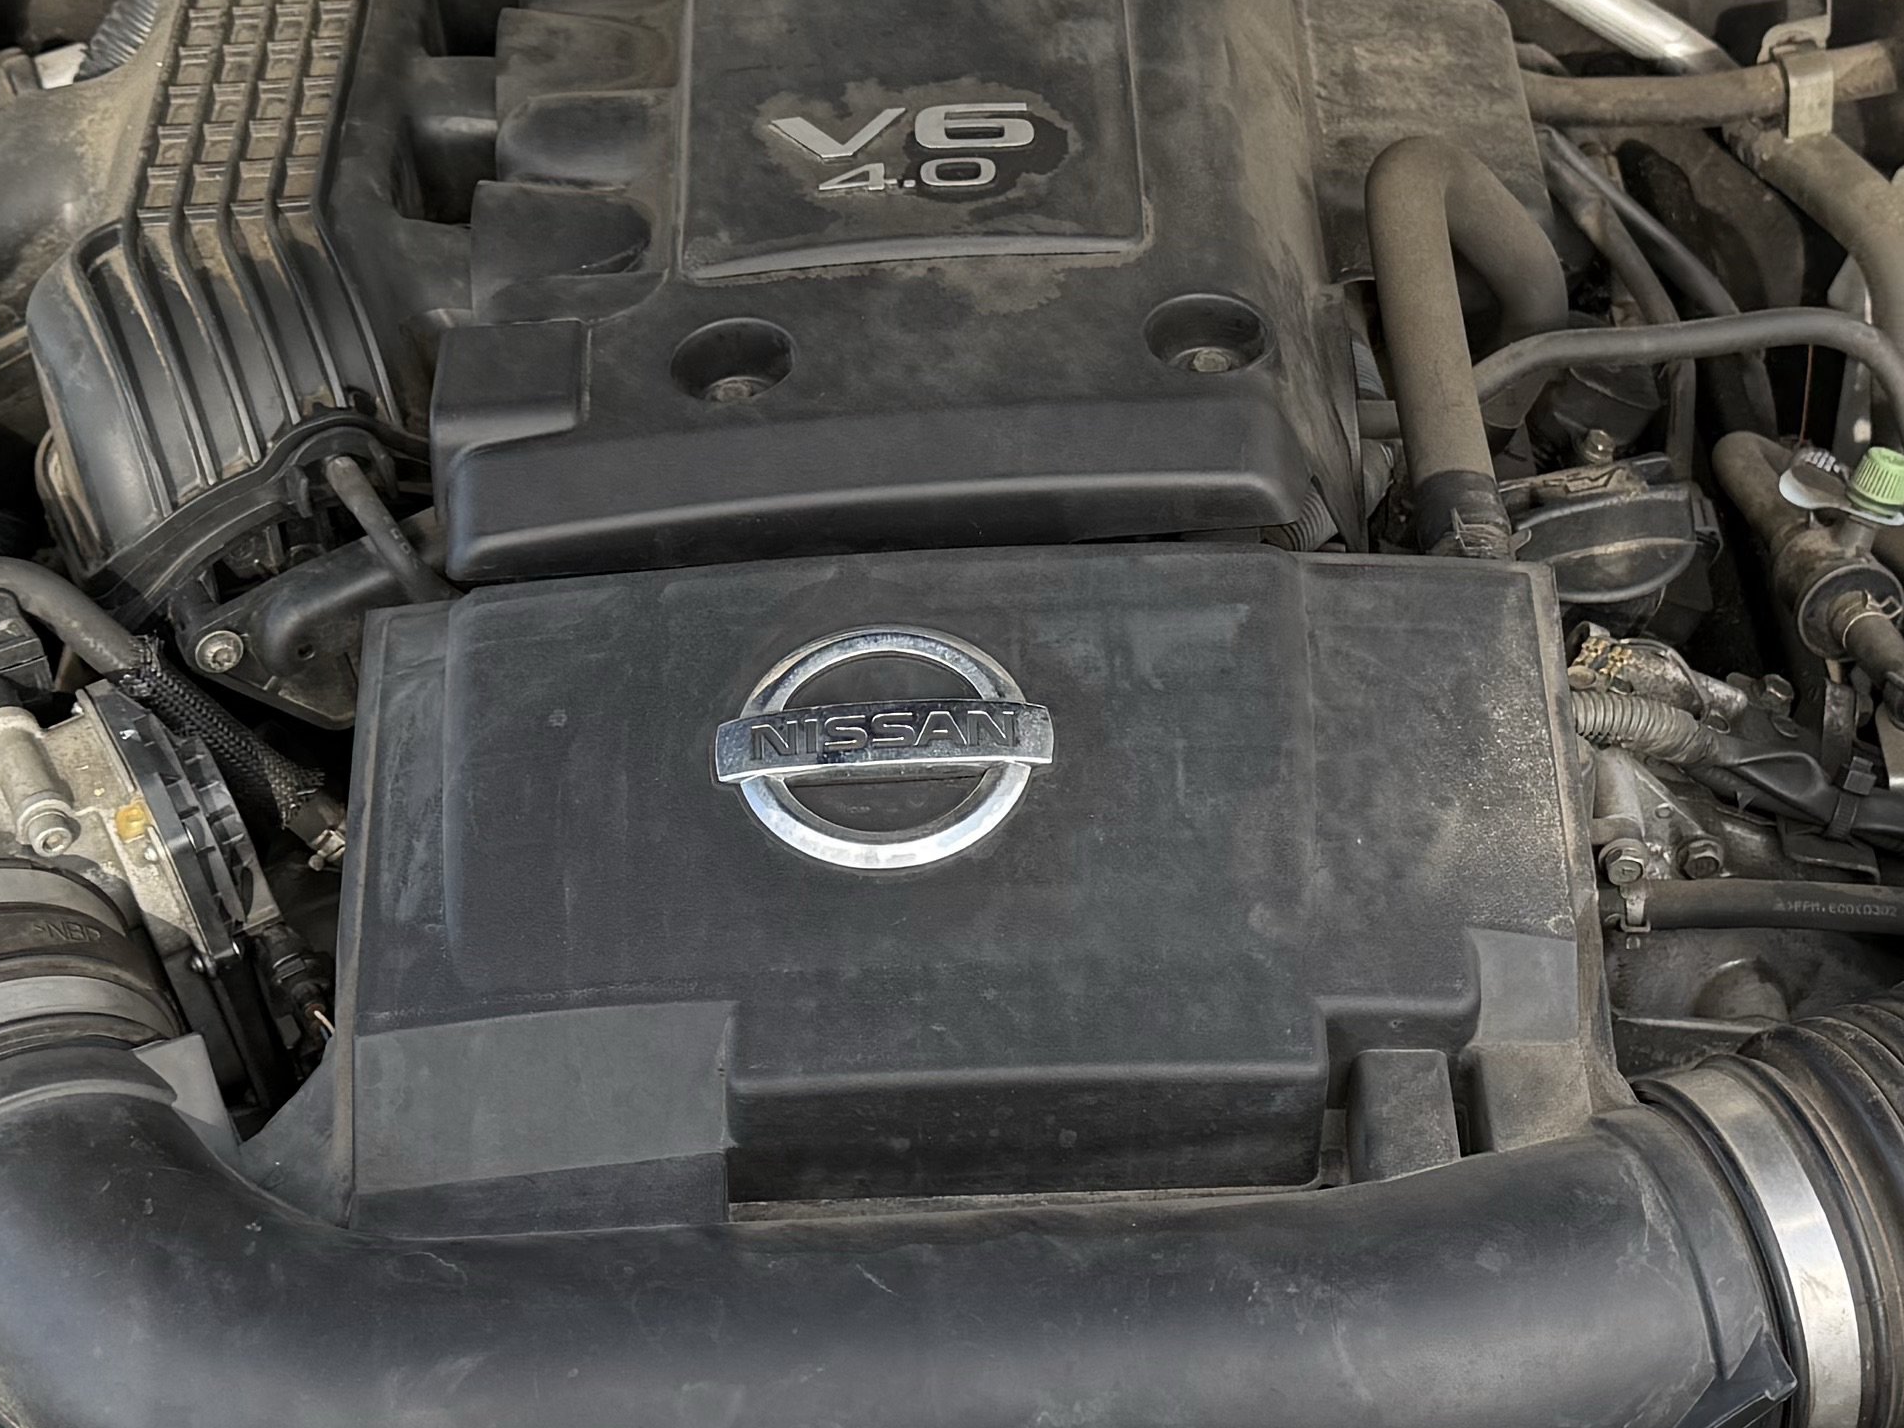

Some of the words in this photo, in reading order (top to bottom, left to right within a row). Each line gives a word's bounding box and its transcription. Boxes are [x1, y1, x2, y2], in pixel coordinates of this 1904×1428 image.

[769, 102, 1035, 160] V6
[818, 156, 997, 192] 4.0
[751, 710, 1016, 760] NISSAN
